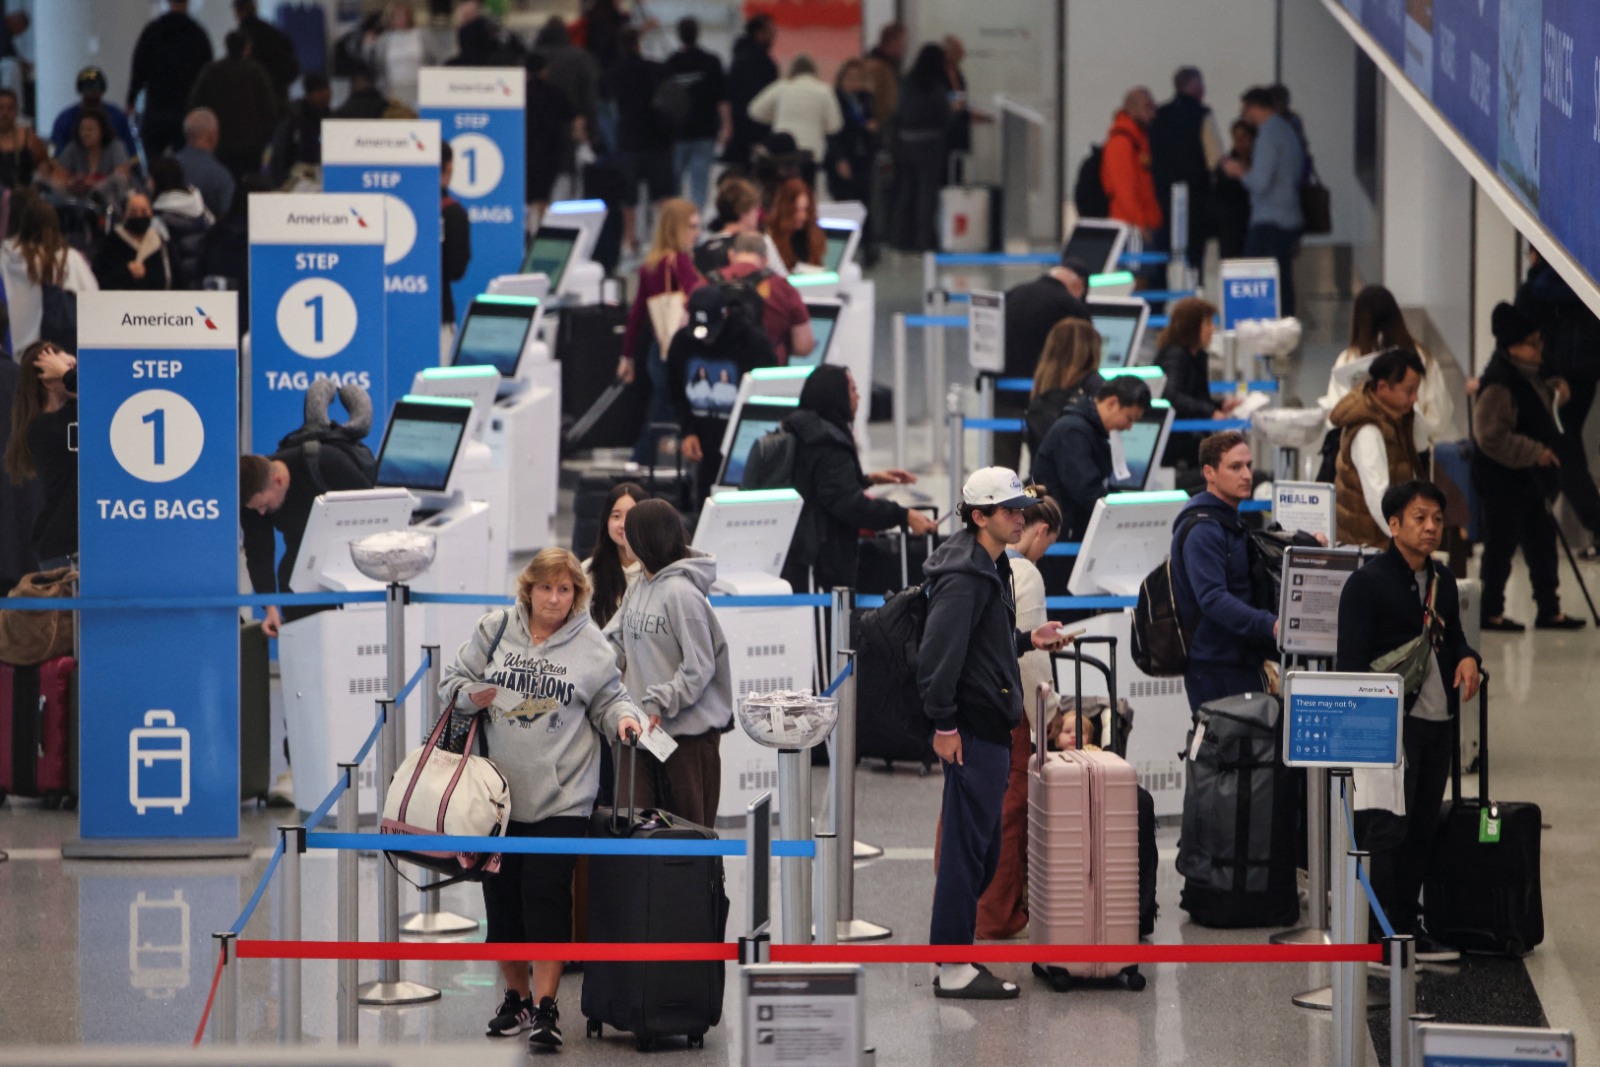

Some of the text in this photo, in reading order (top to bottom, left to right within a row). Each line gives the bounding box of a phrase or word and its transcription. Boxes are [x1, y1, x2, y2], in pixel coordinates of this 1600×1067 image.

[454, 113, 490, 128] STEP
[355, 138, 408, 147] American
[461, 148, 476, 185] 1
[362, 171, 402, 188] STEP
[287, 213, 349, 225] American
[295, 253, 339, 270] STEP
[1230, 281, 1269, 298] EXIT
[121, 313, 194, 327] American
[304, 295, 324, 343] 1
[132, 360, 183, 379] STEP
[265, 371, 309, 390] TAG
[142, 408, 165, 465] 1
[1279, 494, 1319, 504] REAL ID
[97, 499, 220, 520] TAG BAGS
[504, 652, 567, 676] World Series
[1296, 699, 1316, 707] These
[1318, 701, 1332, 709] may
[1514, 1045, 1550, 1055] American
